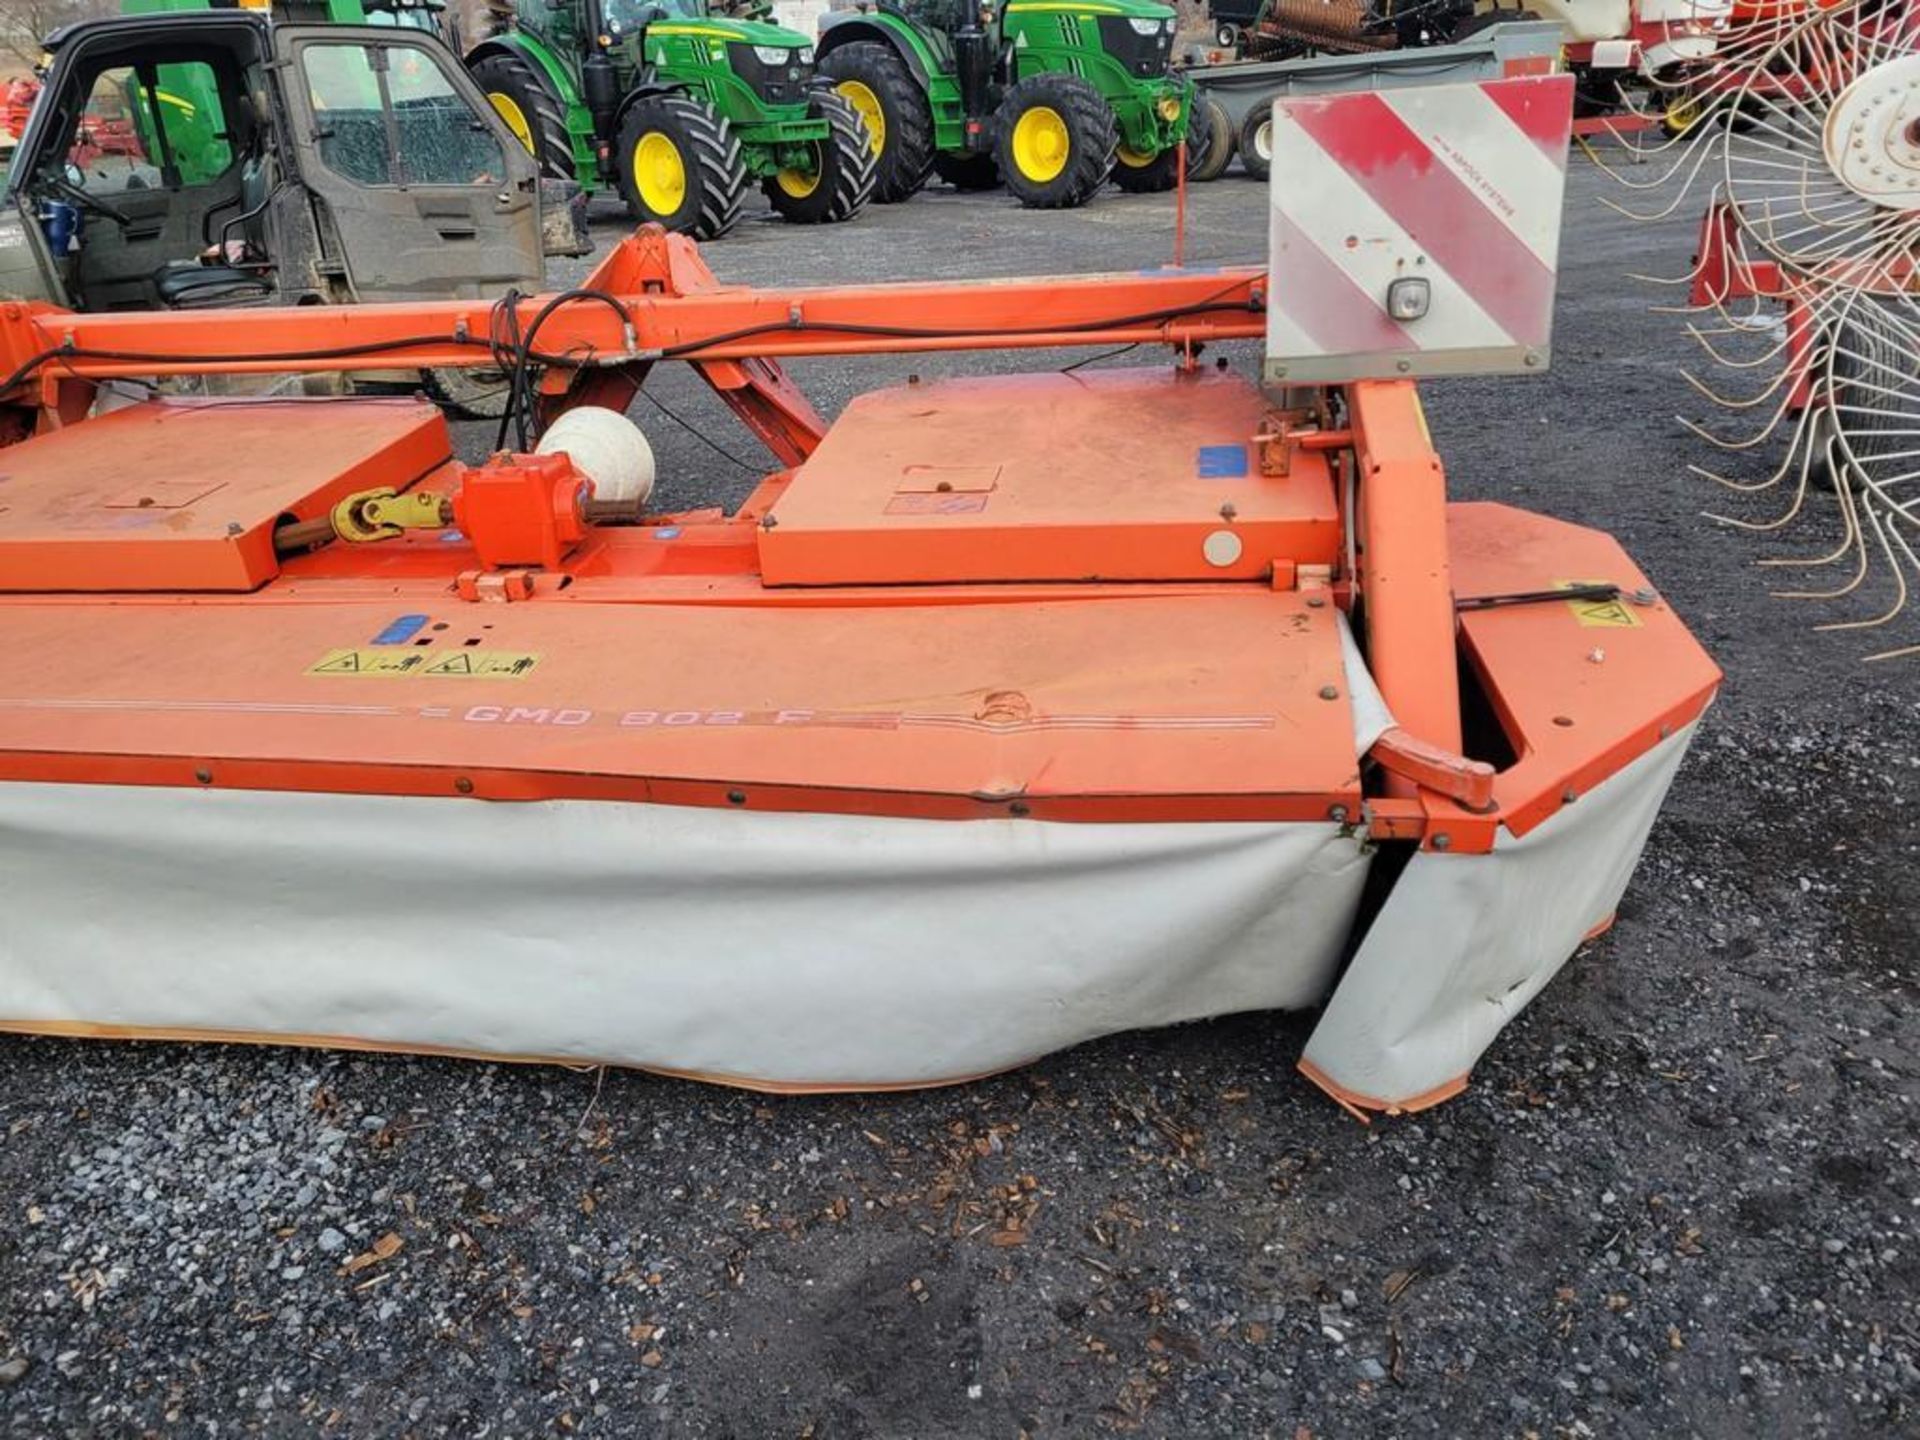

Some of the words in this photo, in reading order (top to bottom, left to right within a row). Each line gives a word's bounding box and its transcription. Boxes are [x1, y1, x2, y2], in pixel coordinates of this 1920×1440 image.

[464, 705, 592, 726] GMD
[619, 710, 744, 727] 802
[773, 710, 816, 725] F
